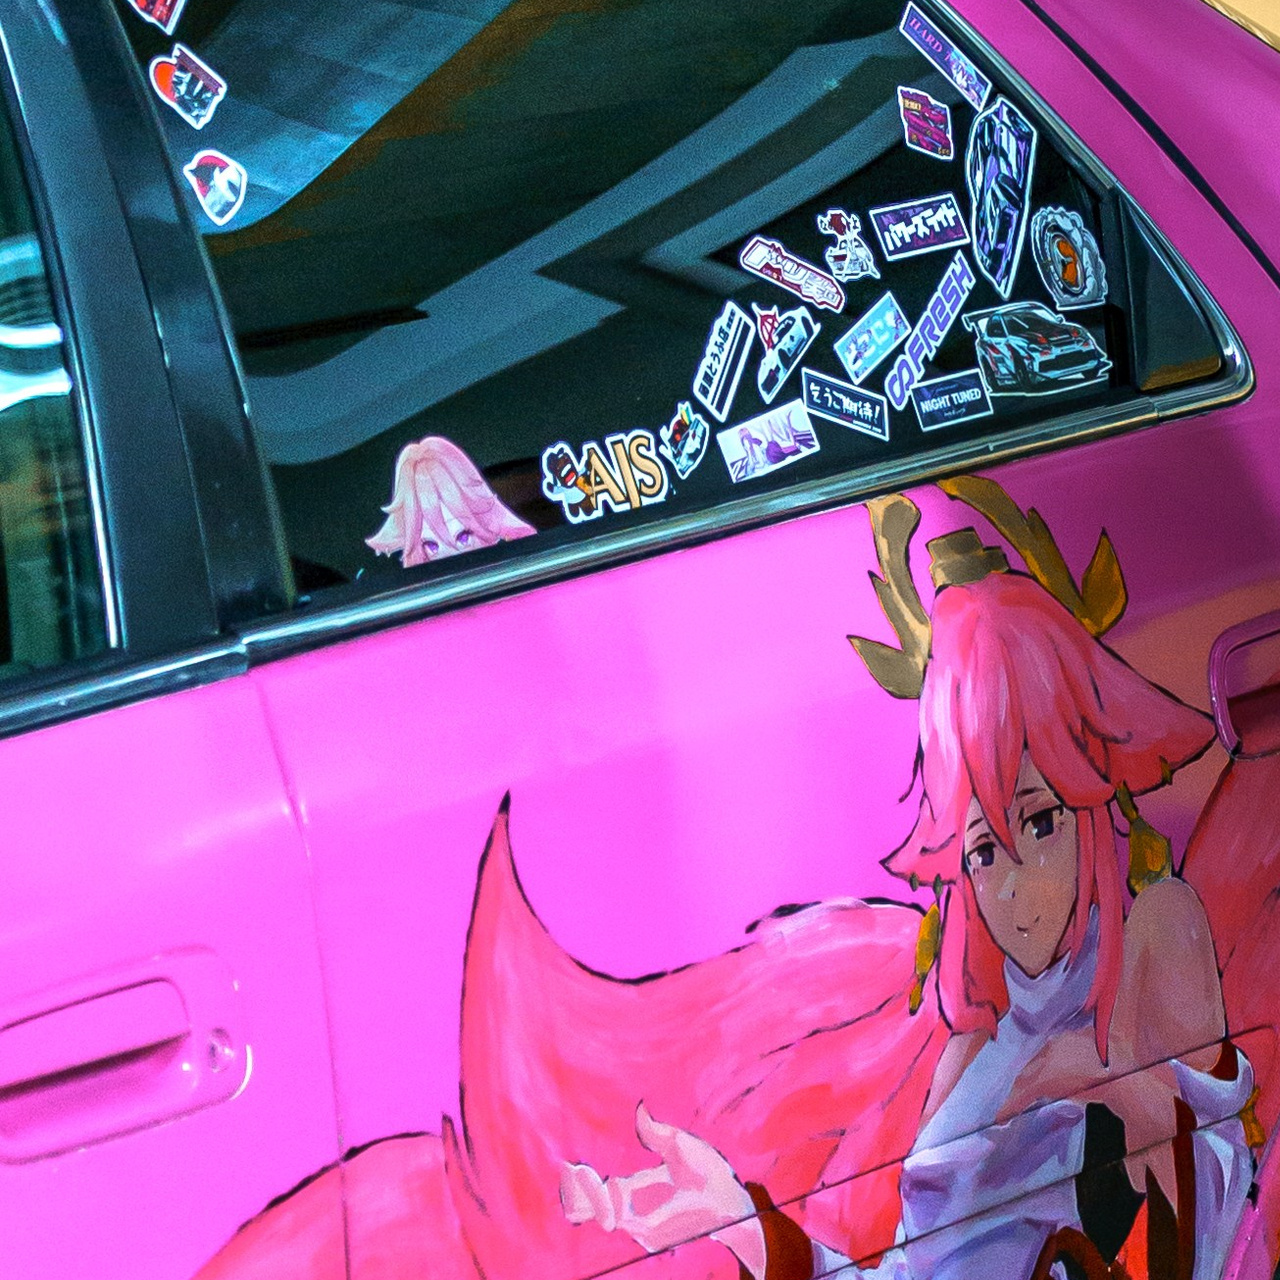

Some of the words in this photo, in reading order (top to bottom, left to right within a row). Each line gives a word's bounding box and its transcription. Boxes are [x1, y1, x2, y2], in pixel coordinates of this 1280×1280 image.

[909, 17, 943, 53] HARD
[920, 395, 951, 414] NIGHT
[951, 388, 982, 406] TUNED
